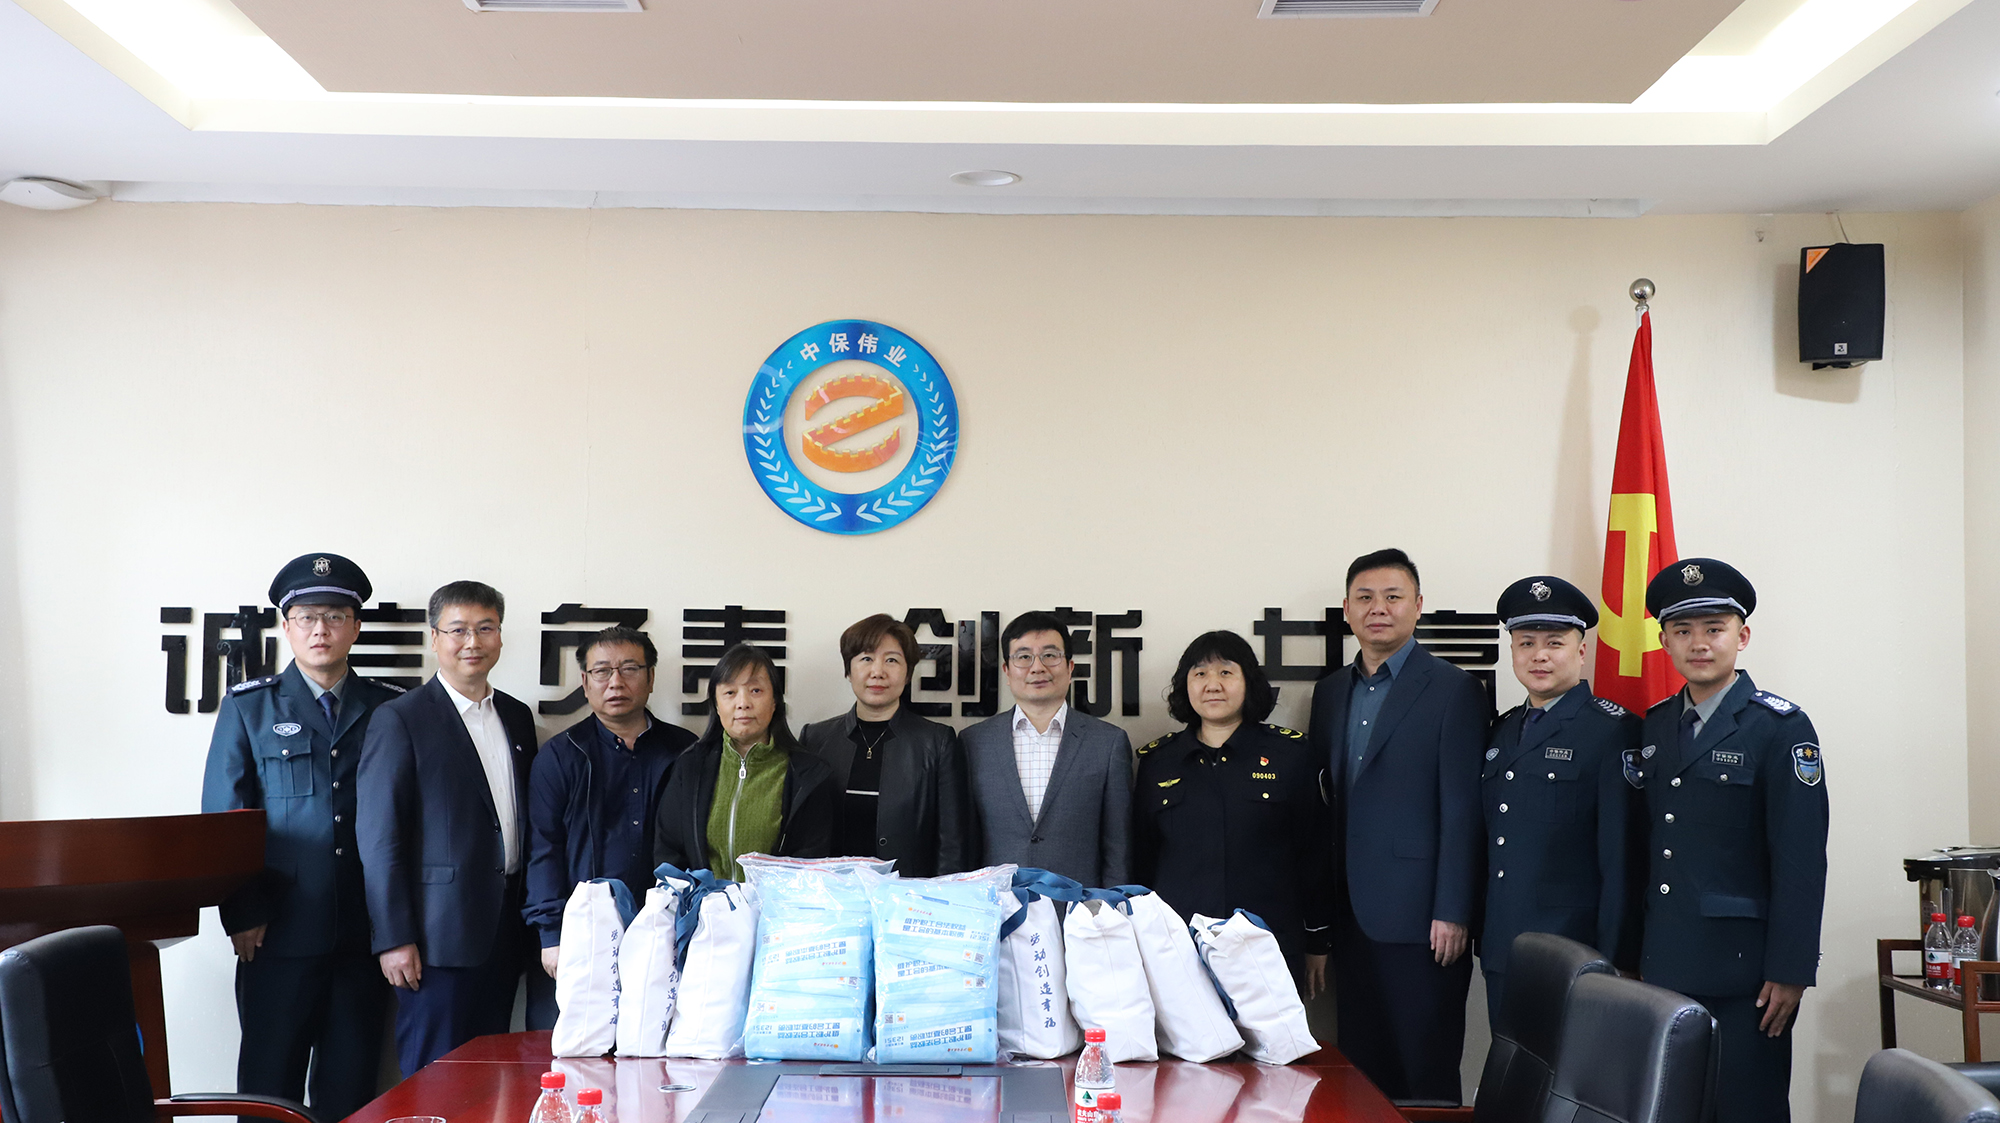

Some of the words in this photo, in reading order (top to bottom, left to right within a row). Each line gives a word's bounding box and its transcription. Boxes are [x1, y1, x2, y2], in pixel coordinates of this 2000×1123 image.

[800, 333, 907, 368] 中保伟业
[900, 607, 1143, 717] 创新
[1252, 772, 1276, 780] 090403
[897, 959, 934, 970] 维护职工
[1030, 932, 1056, 1028] 劳动创造幸福
[777, 1022, 840, 1031] 是工会的基本职责
[909, 1025, 972, 1041] 是工会的基本职责
[777, 1030, 840, 1039] 维护职工合法权益
[884, 1035, 904, 1044] 12351
[909, 1033, 972, 1049] 维护职工合法权益
